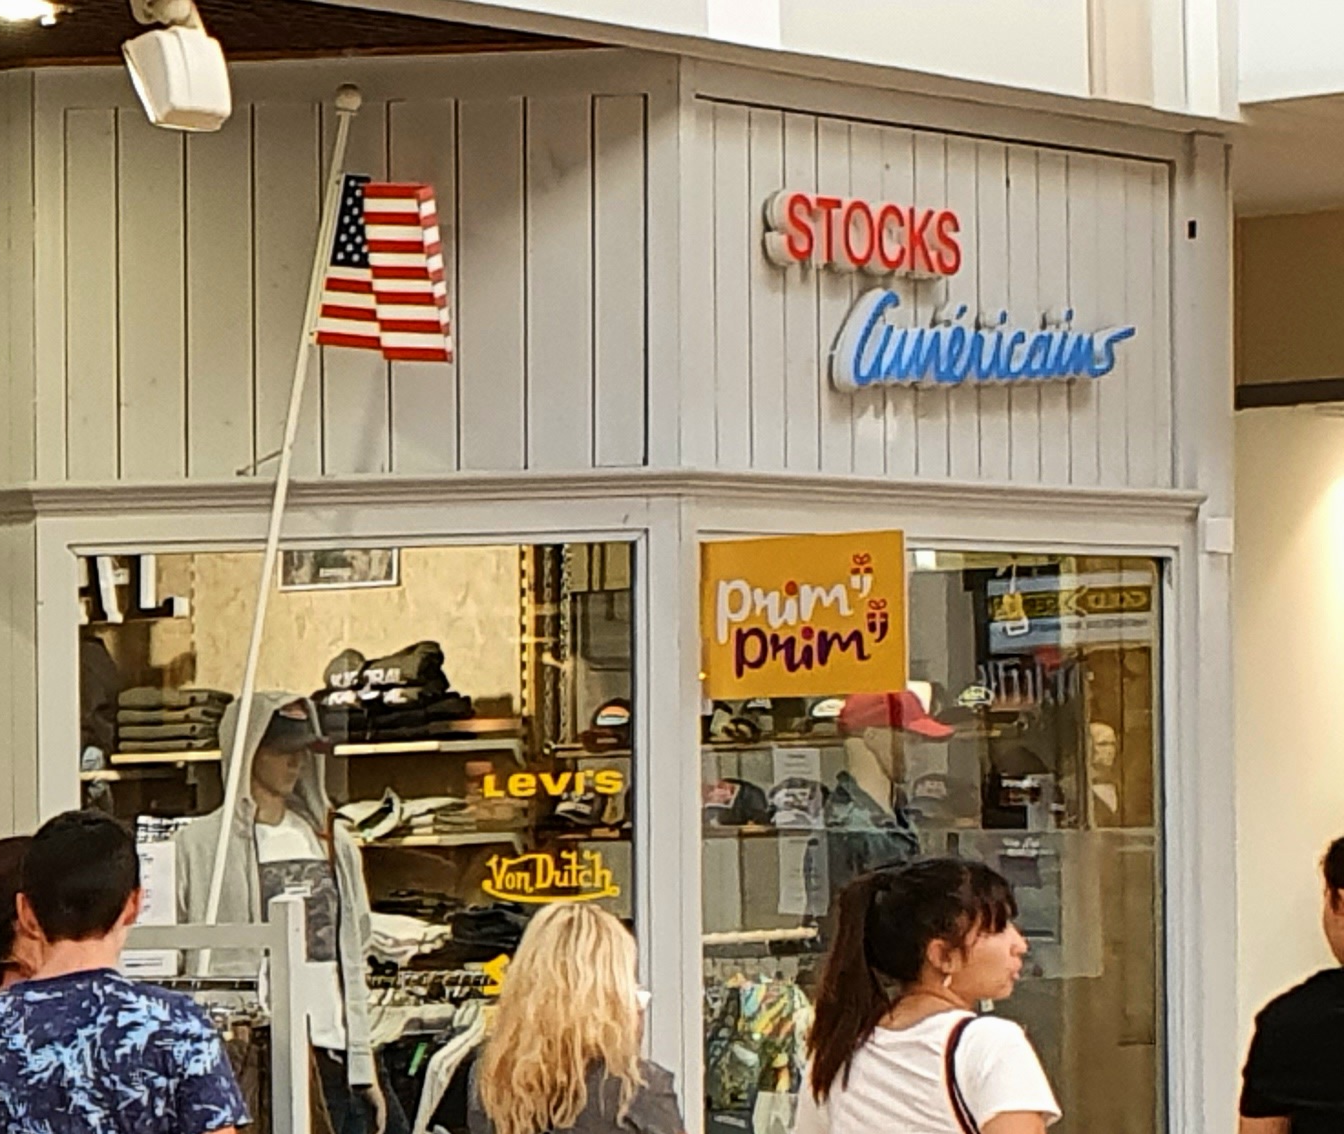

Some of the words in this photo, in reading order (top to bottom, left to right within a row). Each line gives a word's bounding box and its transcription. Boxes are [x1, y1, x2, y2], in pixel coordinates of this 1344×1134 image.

[784, 192, 964, 277] STOCKS
[486, 854, 535, 893] Von
[534, 850, 613, 892] Dutch
